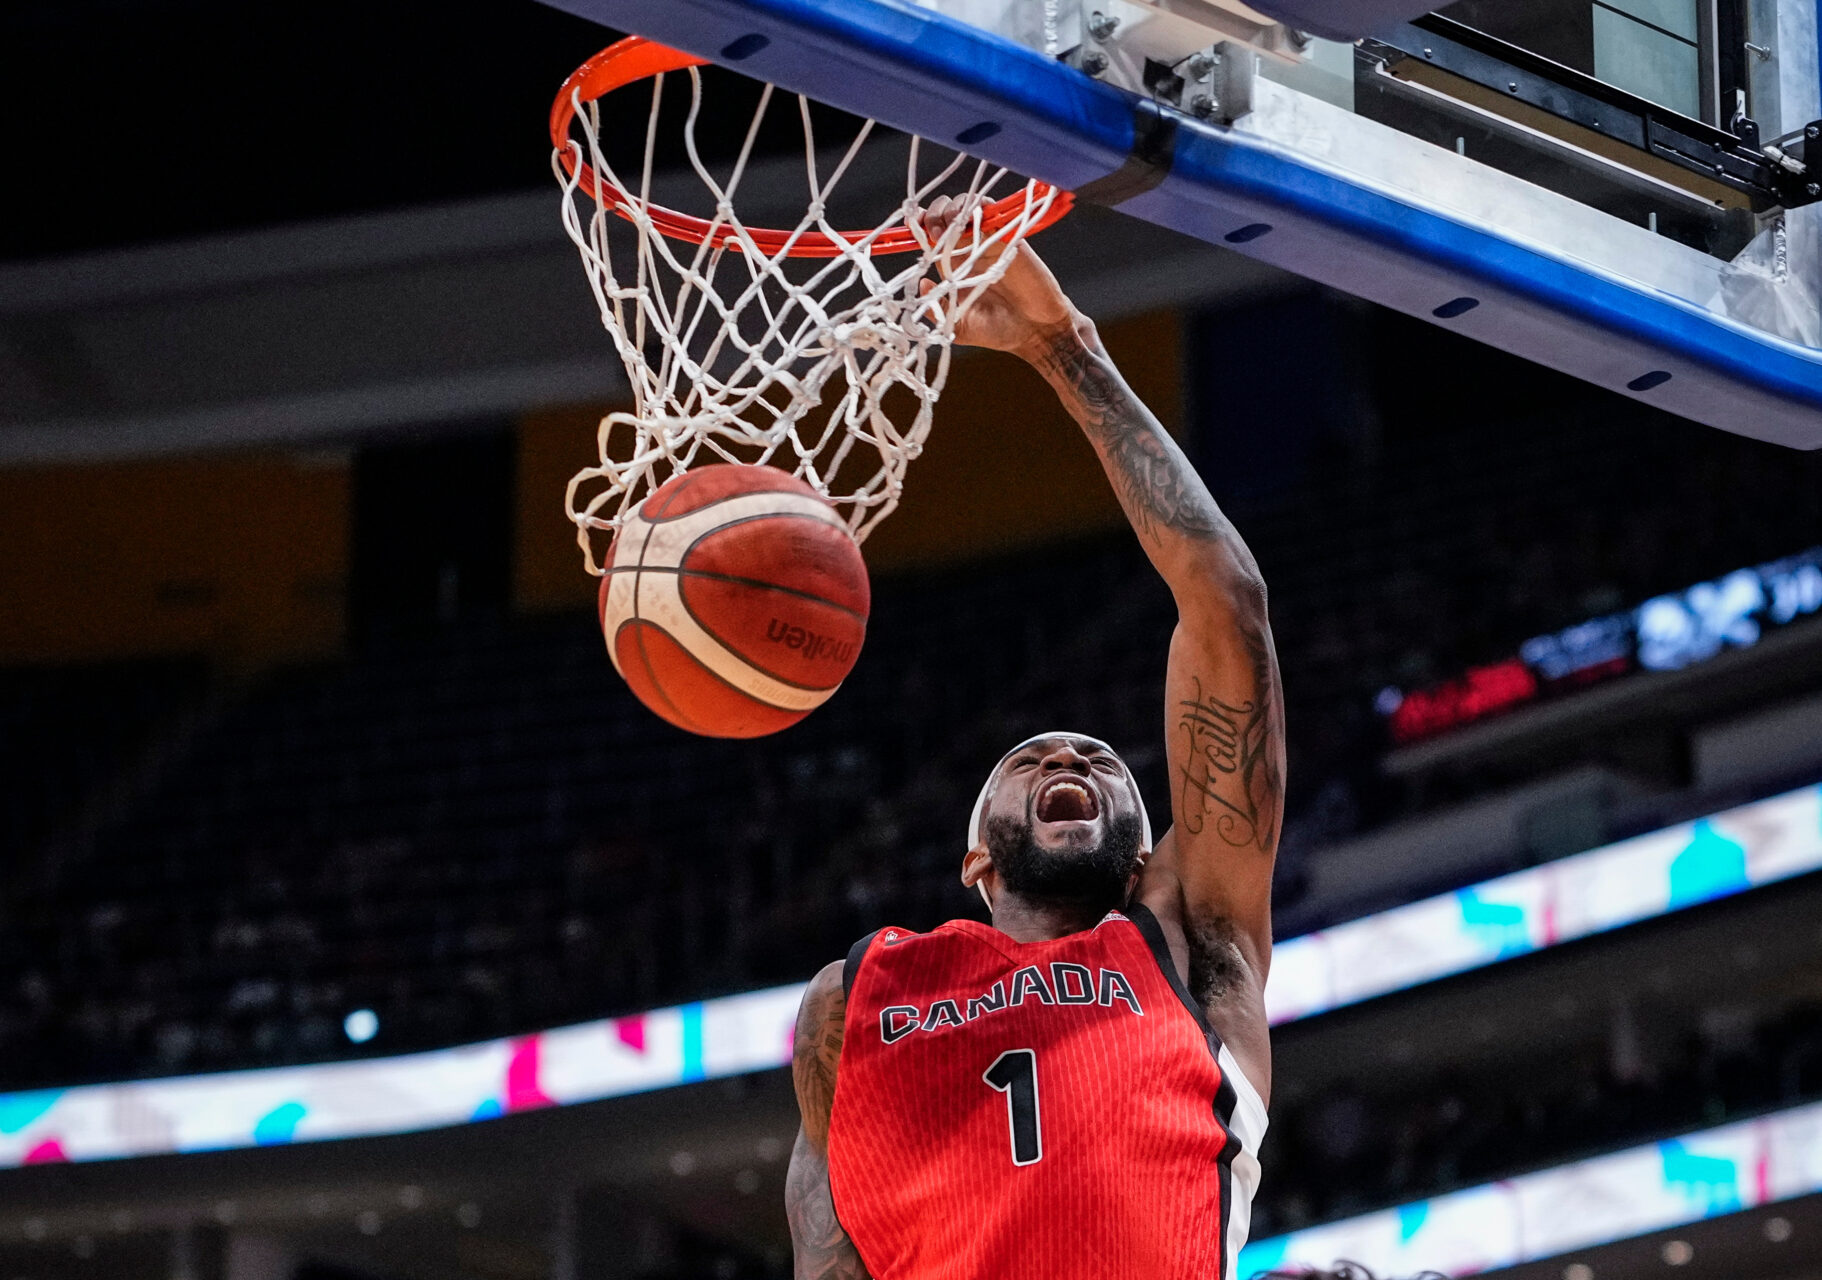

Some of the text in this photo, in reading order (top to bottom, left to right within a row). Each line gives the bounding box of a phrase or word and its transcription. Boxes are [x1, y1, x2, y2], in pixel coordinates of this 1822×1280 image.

[766, 618, 855, 663] molten
[879, 961, 1144, 1045] CANADA
[982, 1048, 1043, 1167] 1
